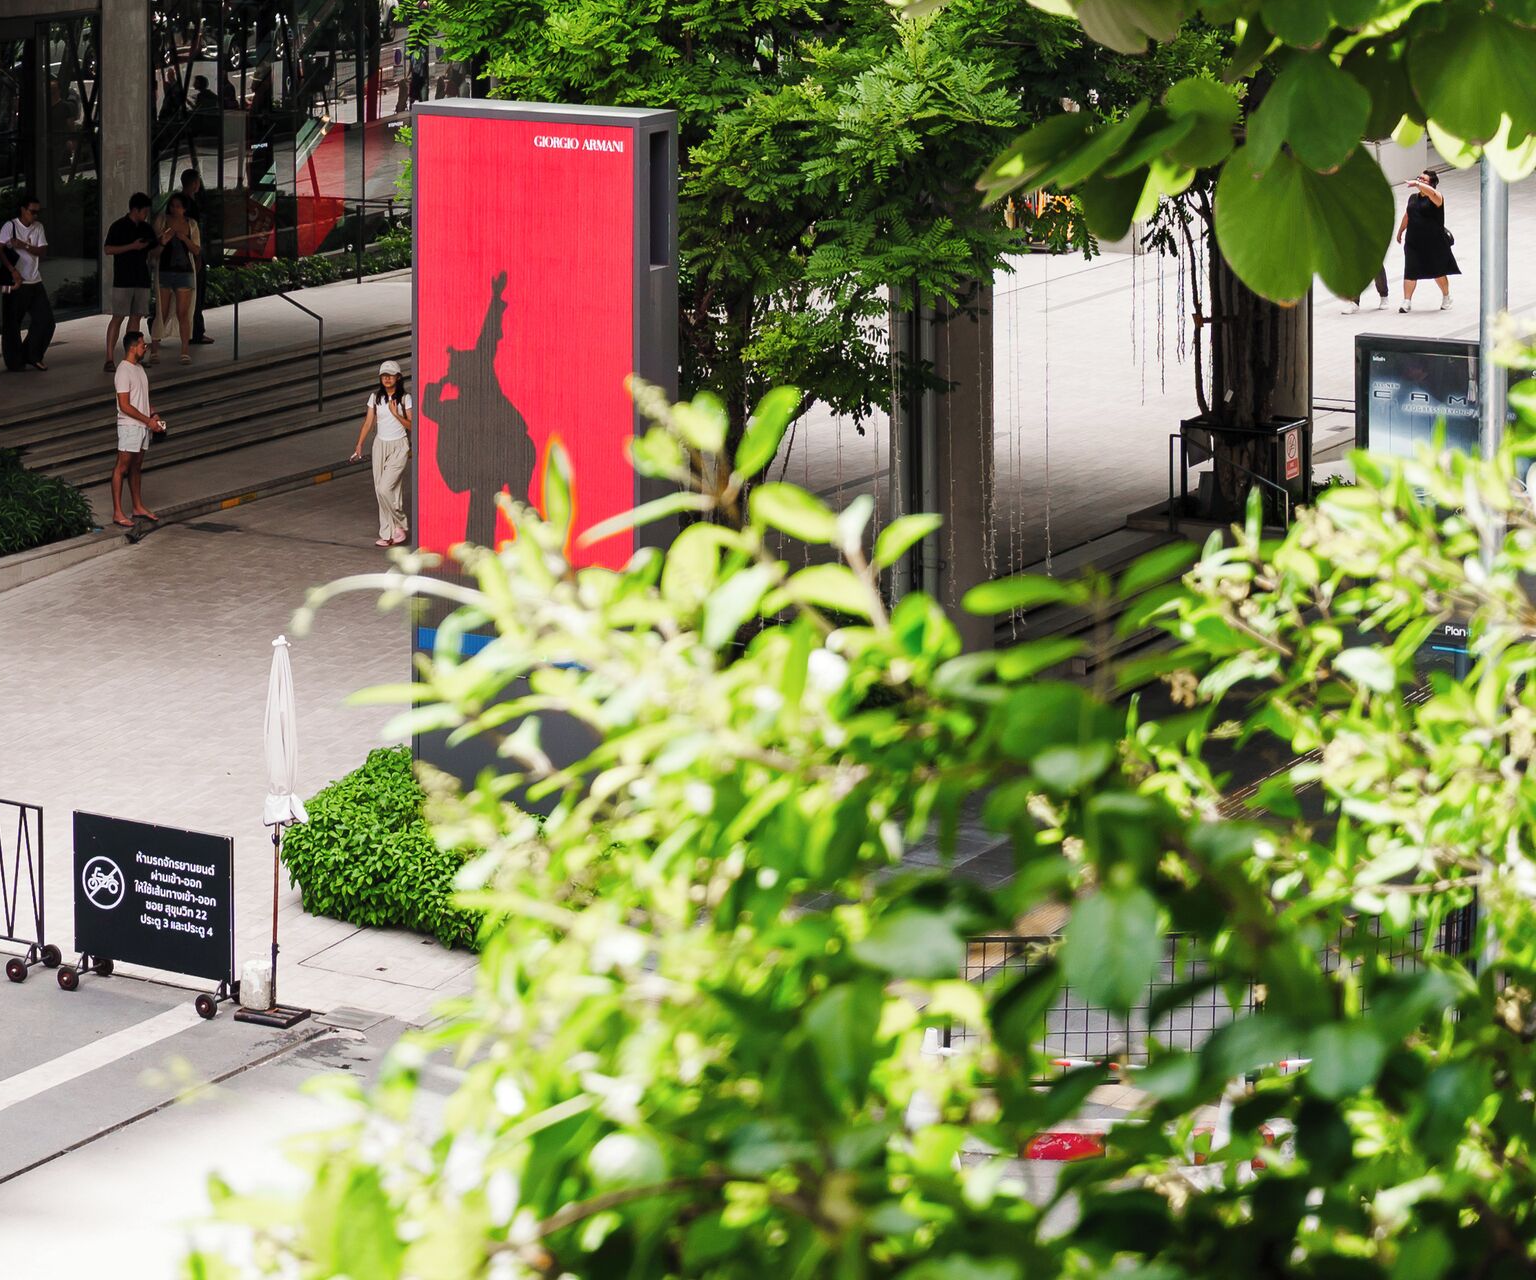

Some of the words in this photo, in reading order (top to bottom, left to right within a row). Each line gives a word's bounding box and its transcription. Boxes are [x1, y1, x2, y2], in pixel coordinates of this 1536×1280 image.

[534, 135, 579, 150] GIORGIO
[582, 138, 624, 153] ARMANI
[1373, 390, 1467, 406] CAM
[136, 851, 215, 876] ห้ามรถจักรยานยนต์
[150, 869, 202, 889] ผ่านเข้า-ออก
[134, 880, 216, 907] ให้ใช้เส้นทางเข้า-ออก
[145, 900, 164, 912] ซอย
[165, 904, 194, 918] สุขุมวิท
[195, 909, 208, 921] 22
[140, 913, 162, 930] ประตู
[163, 918, 169, 928] 3
[170, 920, 205, 939] และประตู
[206, 926, 214, 937] 4
